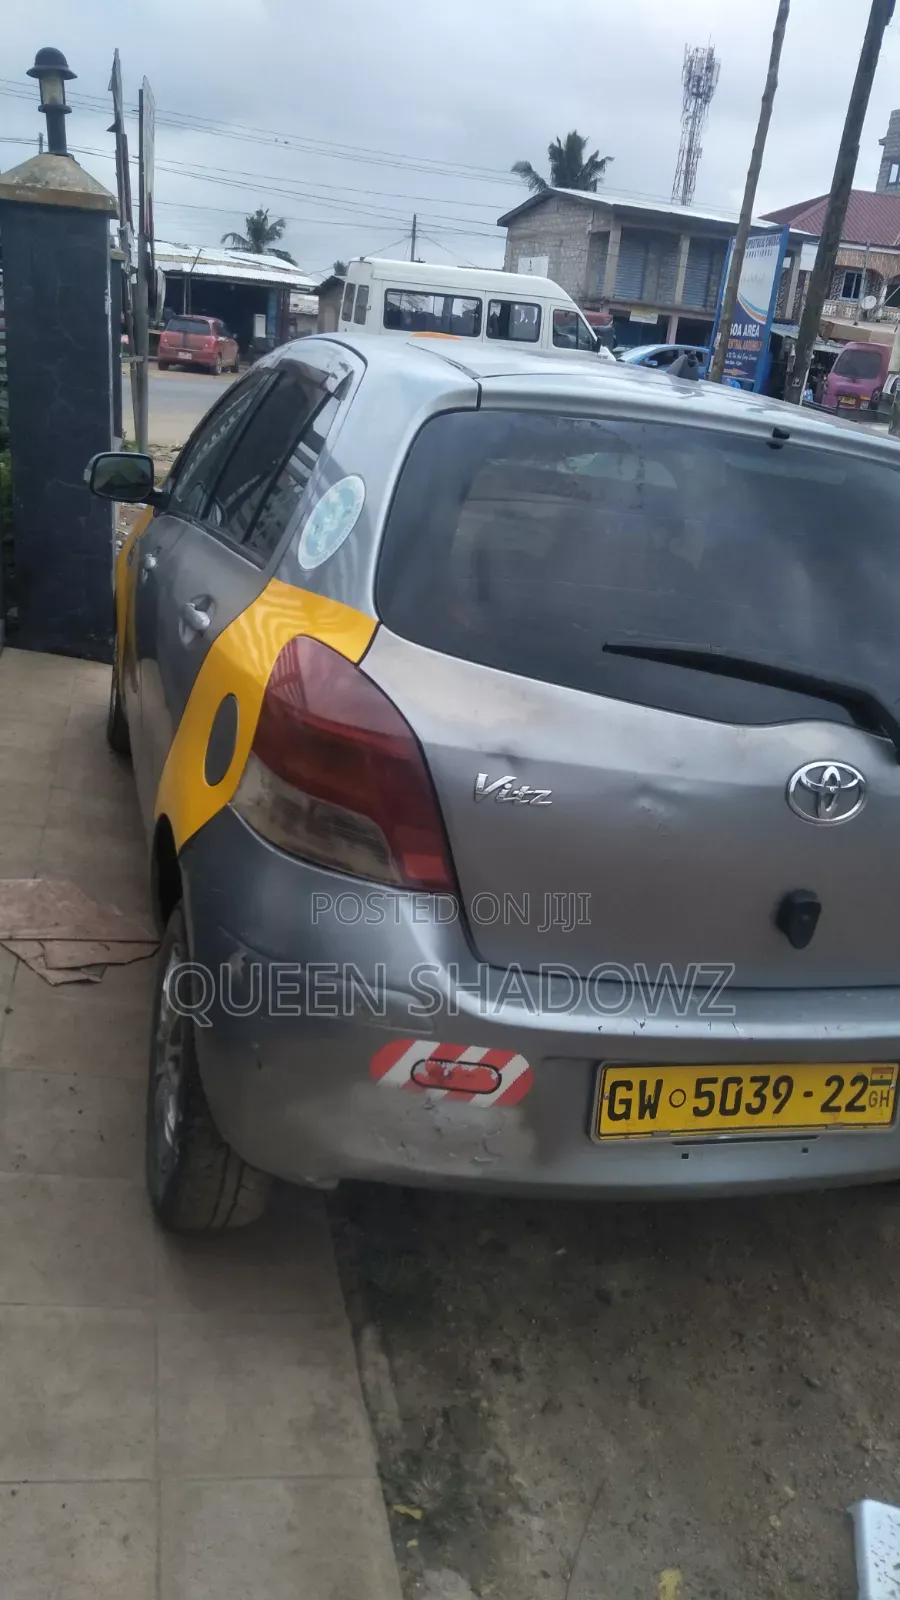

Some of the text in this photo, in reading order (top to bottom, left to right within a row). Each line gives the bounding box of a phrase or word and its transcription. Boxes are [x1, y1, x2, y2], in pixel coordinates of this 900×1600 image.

[742, 324, 760, 338] AREA
[474, 772, 553, 805] Vitz
[607, 1079, 664, 1122] GW
[868, 1089, 890, 1109] GH
